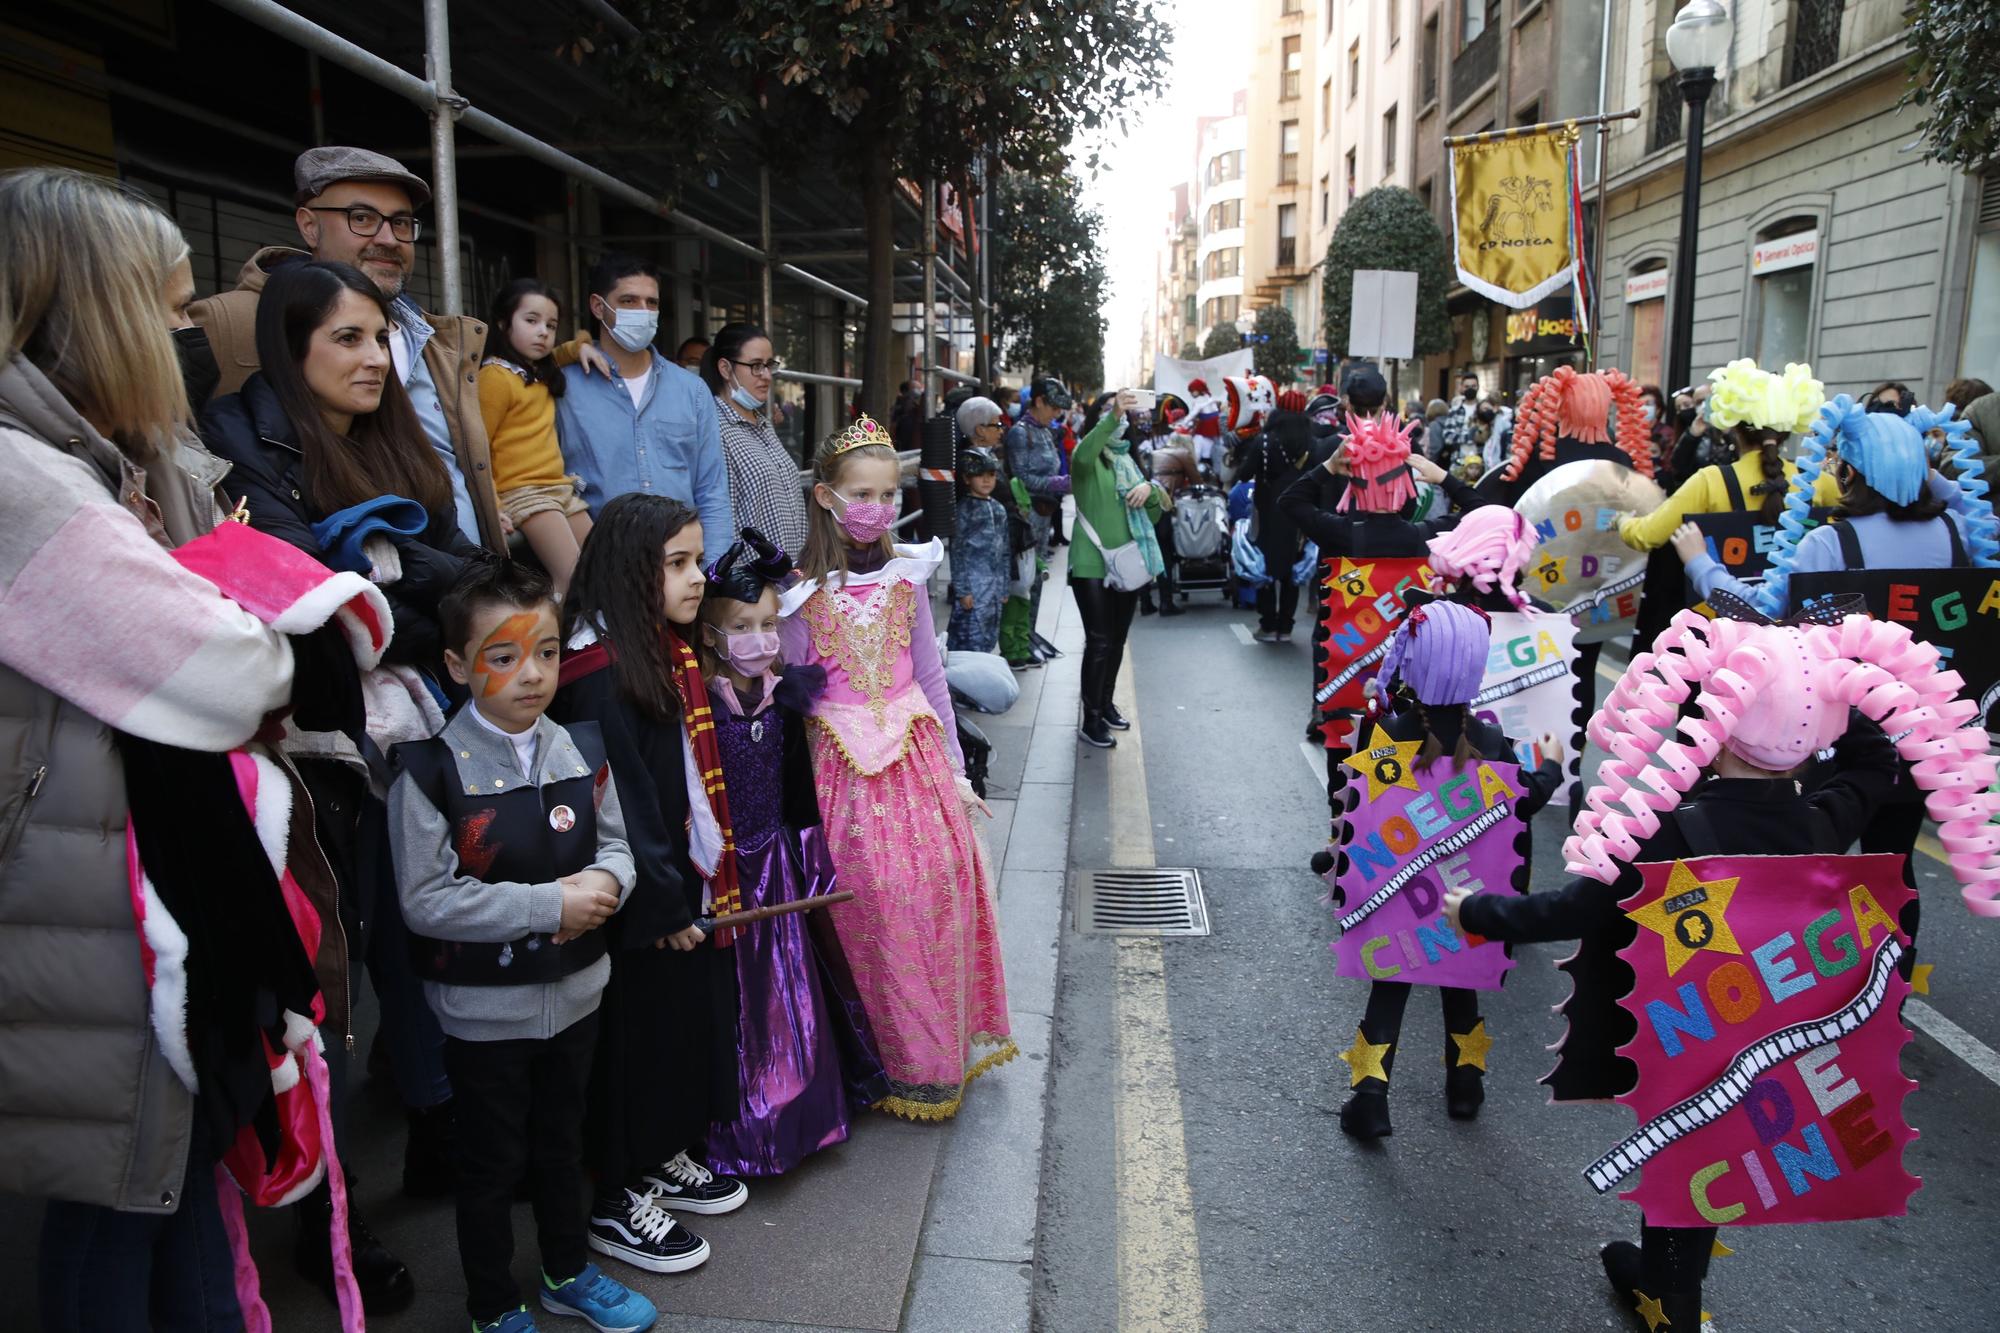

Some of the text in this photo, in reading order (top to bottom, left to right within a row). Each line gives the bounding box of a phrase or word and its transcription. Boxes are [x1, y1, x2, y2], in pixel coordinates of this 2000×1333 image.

[1501, 238, 1553, 248] NOEGA
[1581, 555, 1622, 578] DE
[1347, 764, 1517, 882] NOEGA
[1403, 851, 1485, 919] DE
[1665, 889, 1707, 912] SARA
[1645, 885, 1898, 1058] NOEGA
[1742, 1041, 1862, 1147] DE
[1690, 1091, 1895, 1224] CINE
